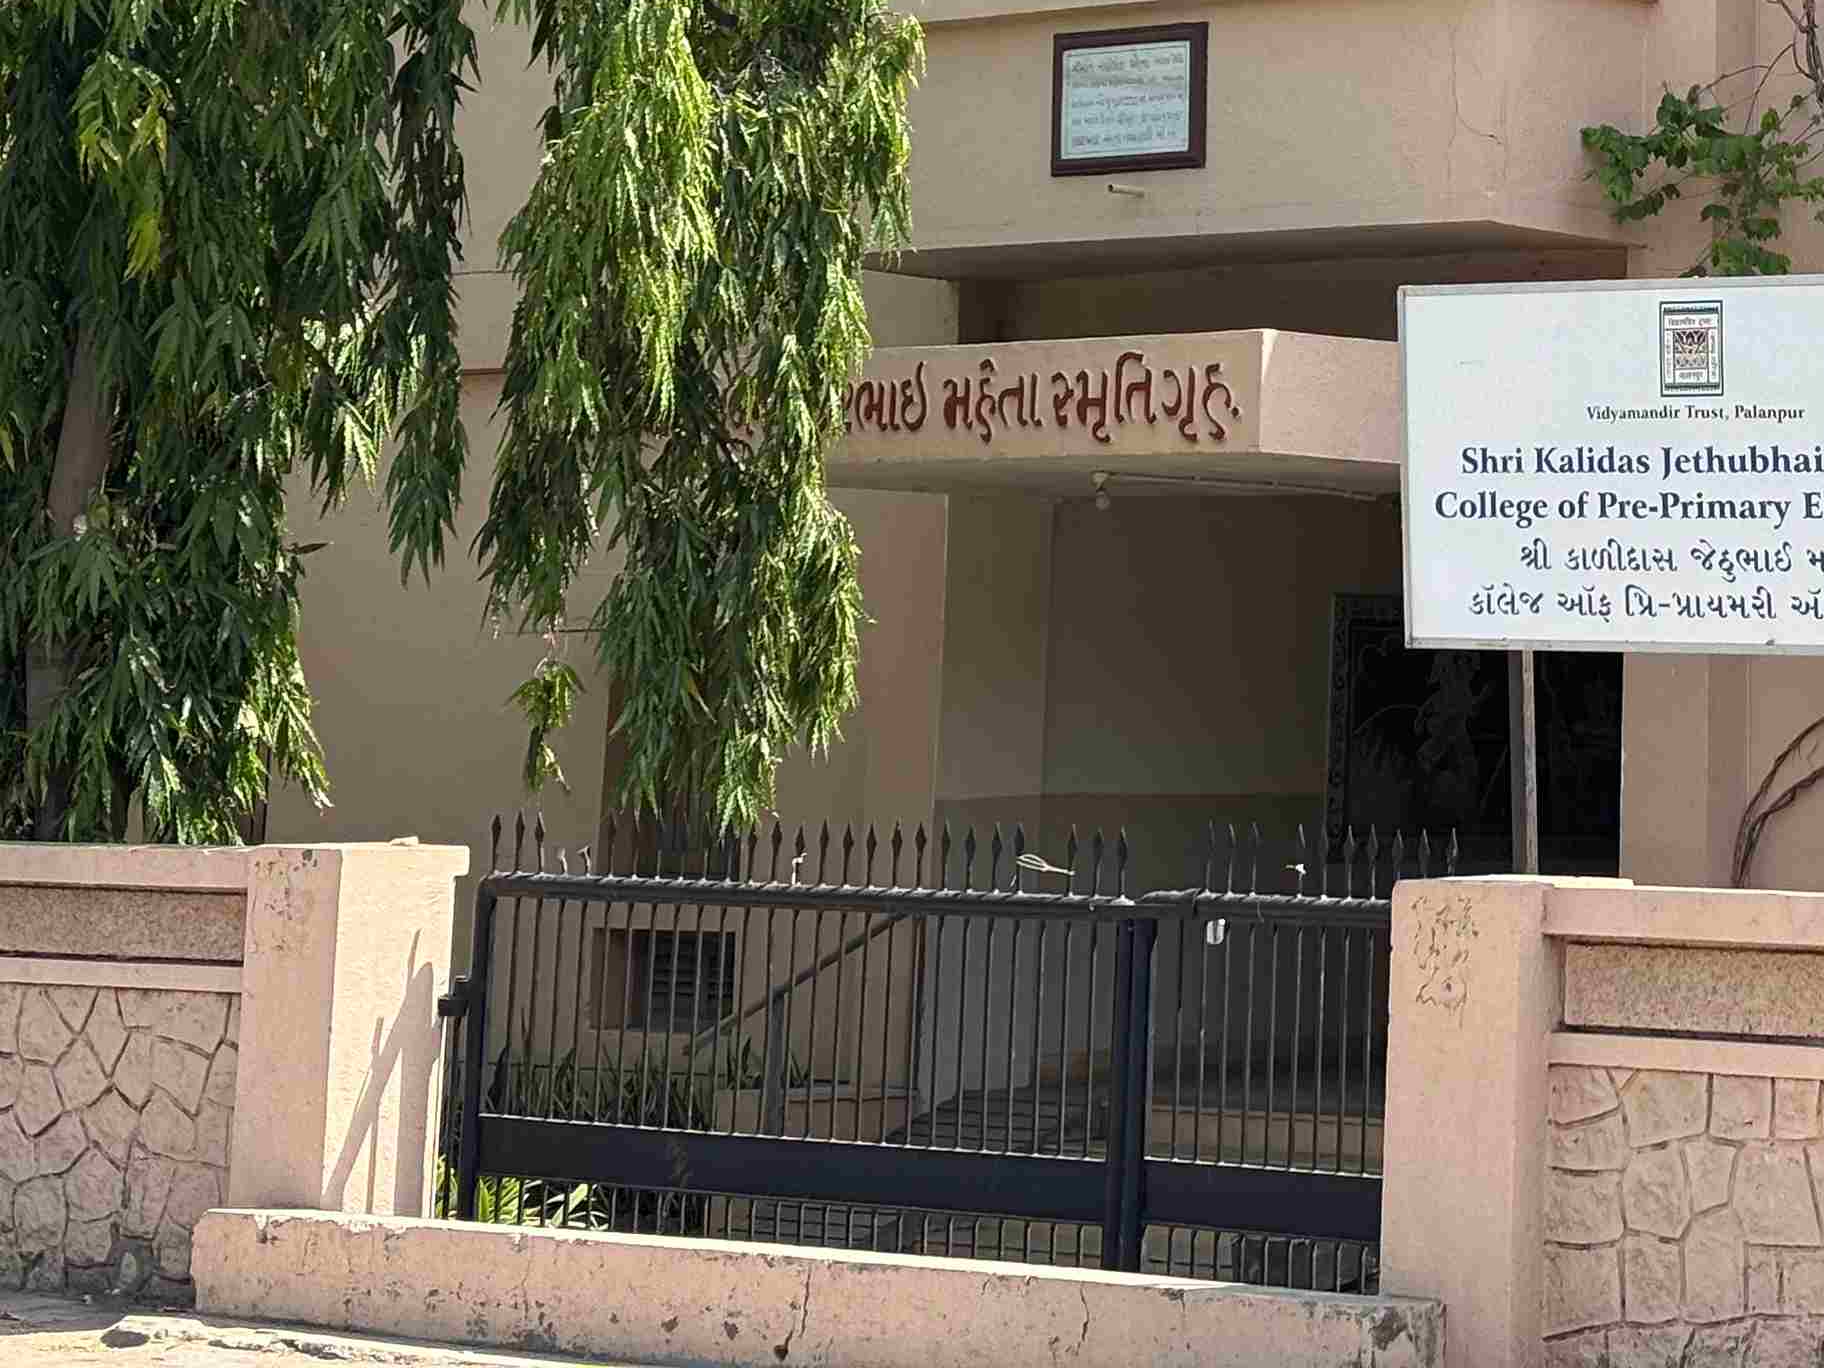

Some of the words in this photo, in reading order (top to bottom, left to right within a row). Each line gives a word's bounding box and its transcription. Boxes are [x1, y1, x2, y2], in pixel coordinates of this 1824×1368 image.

[1586, 405, 1681, 423] Vidyamandir
[1686, 404, 1729, 420] Trust,
[1734, 404, 1805, 423] Palanpur
[1461, 447, 1524, 474] Shri
[1534, 446, 1651, 474] Kalidas
[1660, 445, 1824, 480] Jethubhai
[1434, 491, 1549, 529] College
[1557, 491, 1590, 519] of
[1597, 491, 1792, 530] Pre-Primary
[1520, 537, 1551, 570] શ્રી
[1564, 538, 1679, 572] કાળીદાસ
[1690, 539, 1793, 583] જેઠુભાઈ
